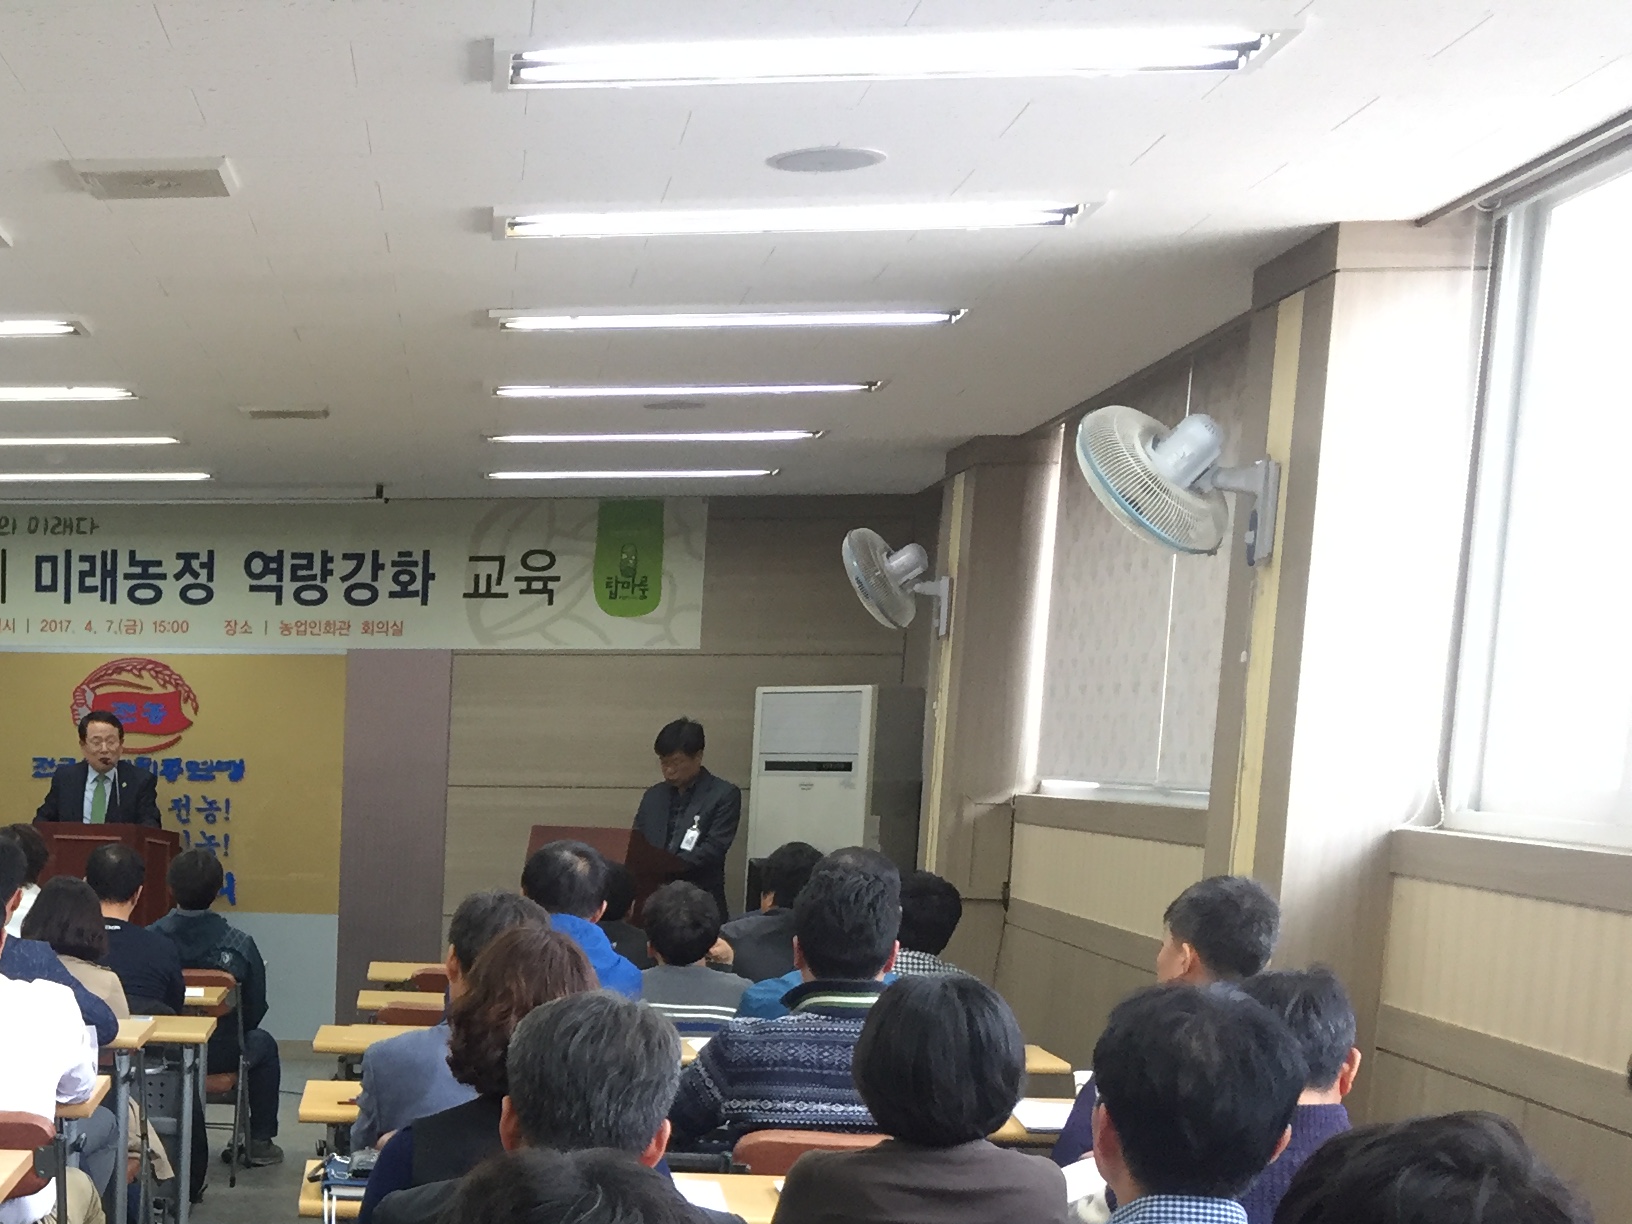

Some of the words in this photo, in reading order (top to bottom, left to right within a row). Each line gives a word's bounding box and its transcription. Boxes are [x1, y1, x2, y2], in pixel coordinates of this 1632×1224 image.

[26, 515, 100, 537] 미래다
[33, 548, 216, 607] 미래농정
[243, 548, 437, 608] 역량강화
[462, 548, 562, 607] 교육
[84, 618, 97, 635] 4.
[152, 618, 190, 634] 15:00
[223, 619, 253, 637] 장소
[279, 619, 352, 637] 농업인회관
[360, 619, 404, 637] 회의실
[182, 829, 231, 857] 농!
